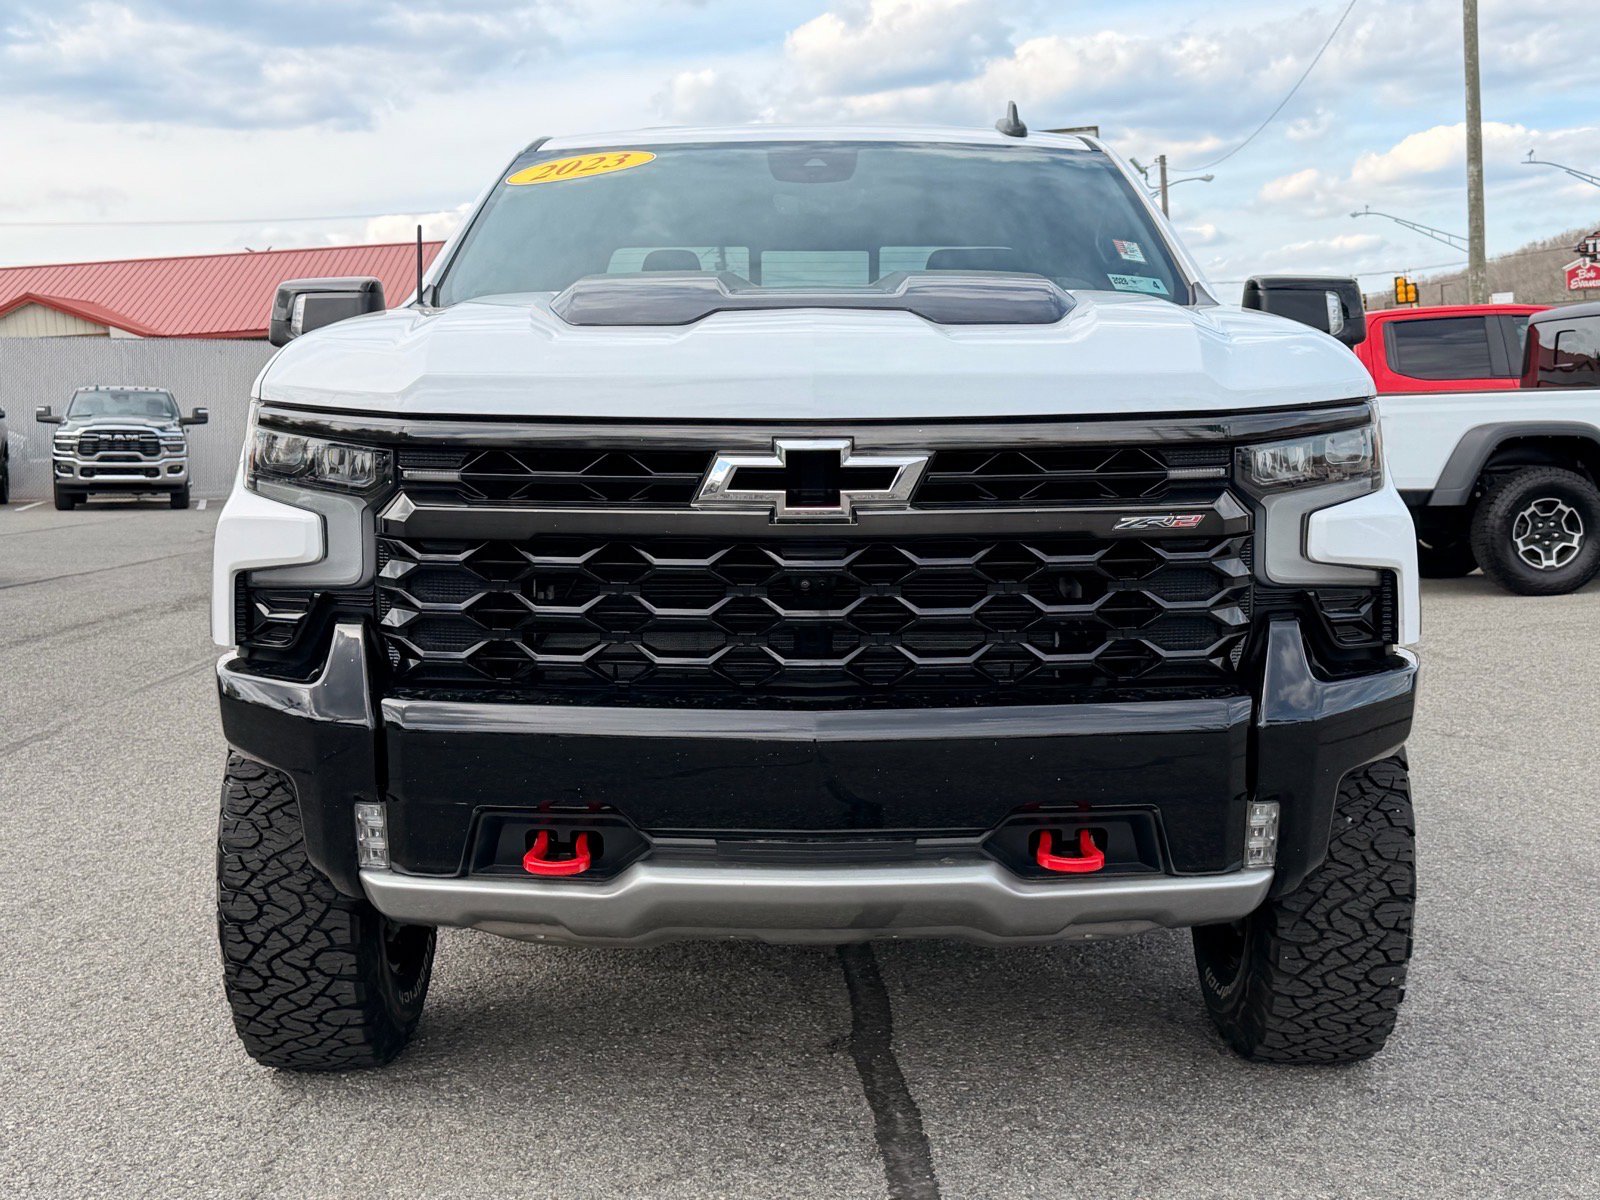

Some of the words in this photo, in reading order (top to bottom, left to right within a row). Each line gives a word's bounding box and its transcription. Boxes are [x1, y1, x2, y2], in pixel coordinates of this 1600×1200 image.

[529, 153, 631, 181] 2023
[1575, 269, 1596, 278] Bob
[1113, 514, 1204, 529] ZR2
